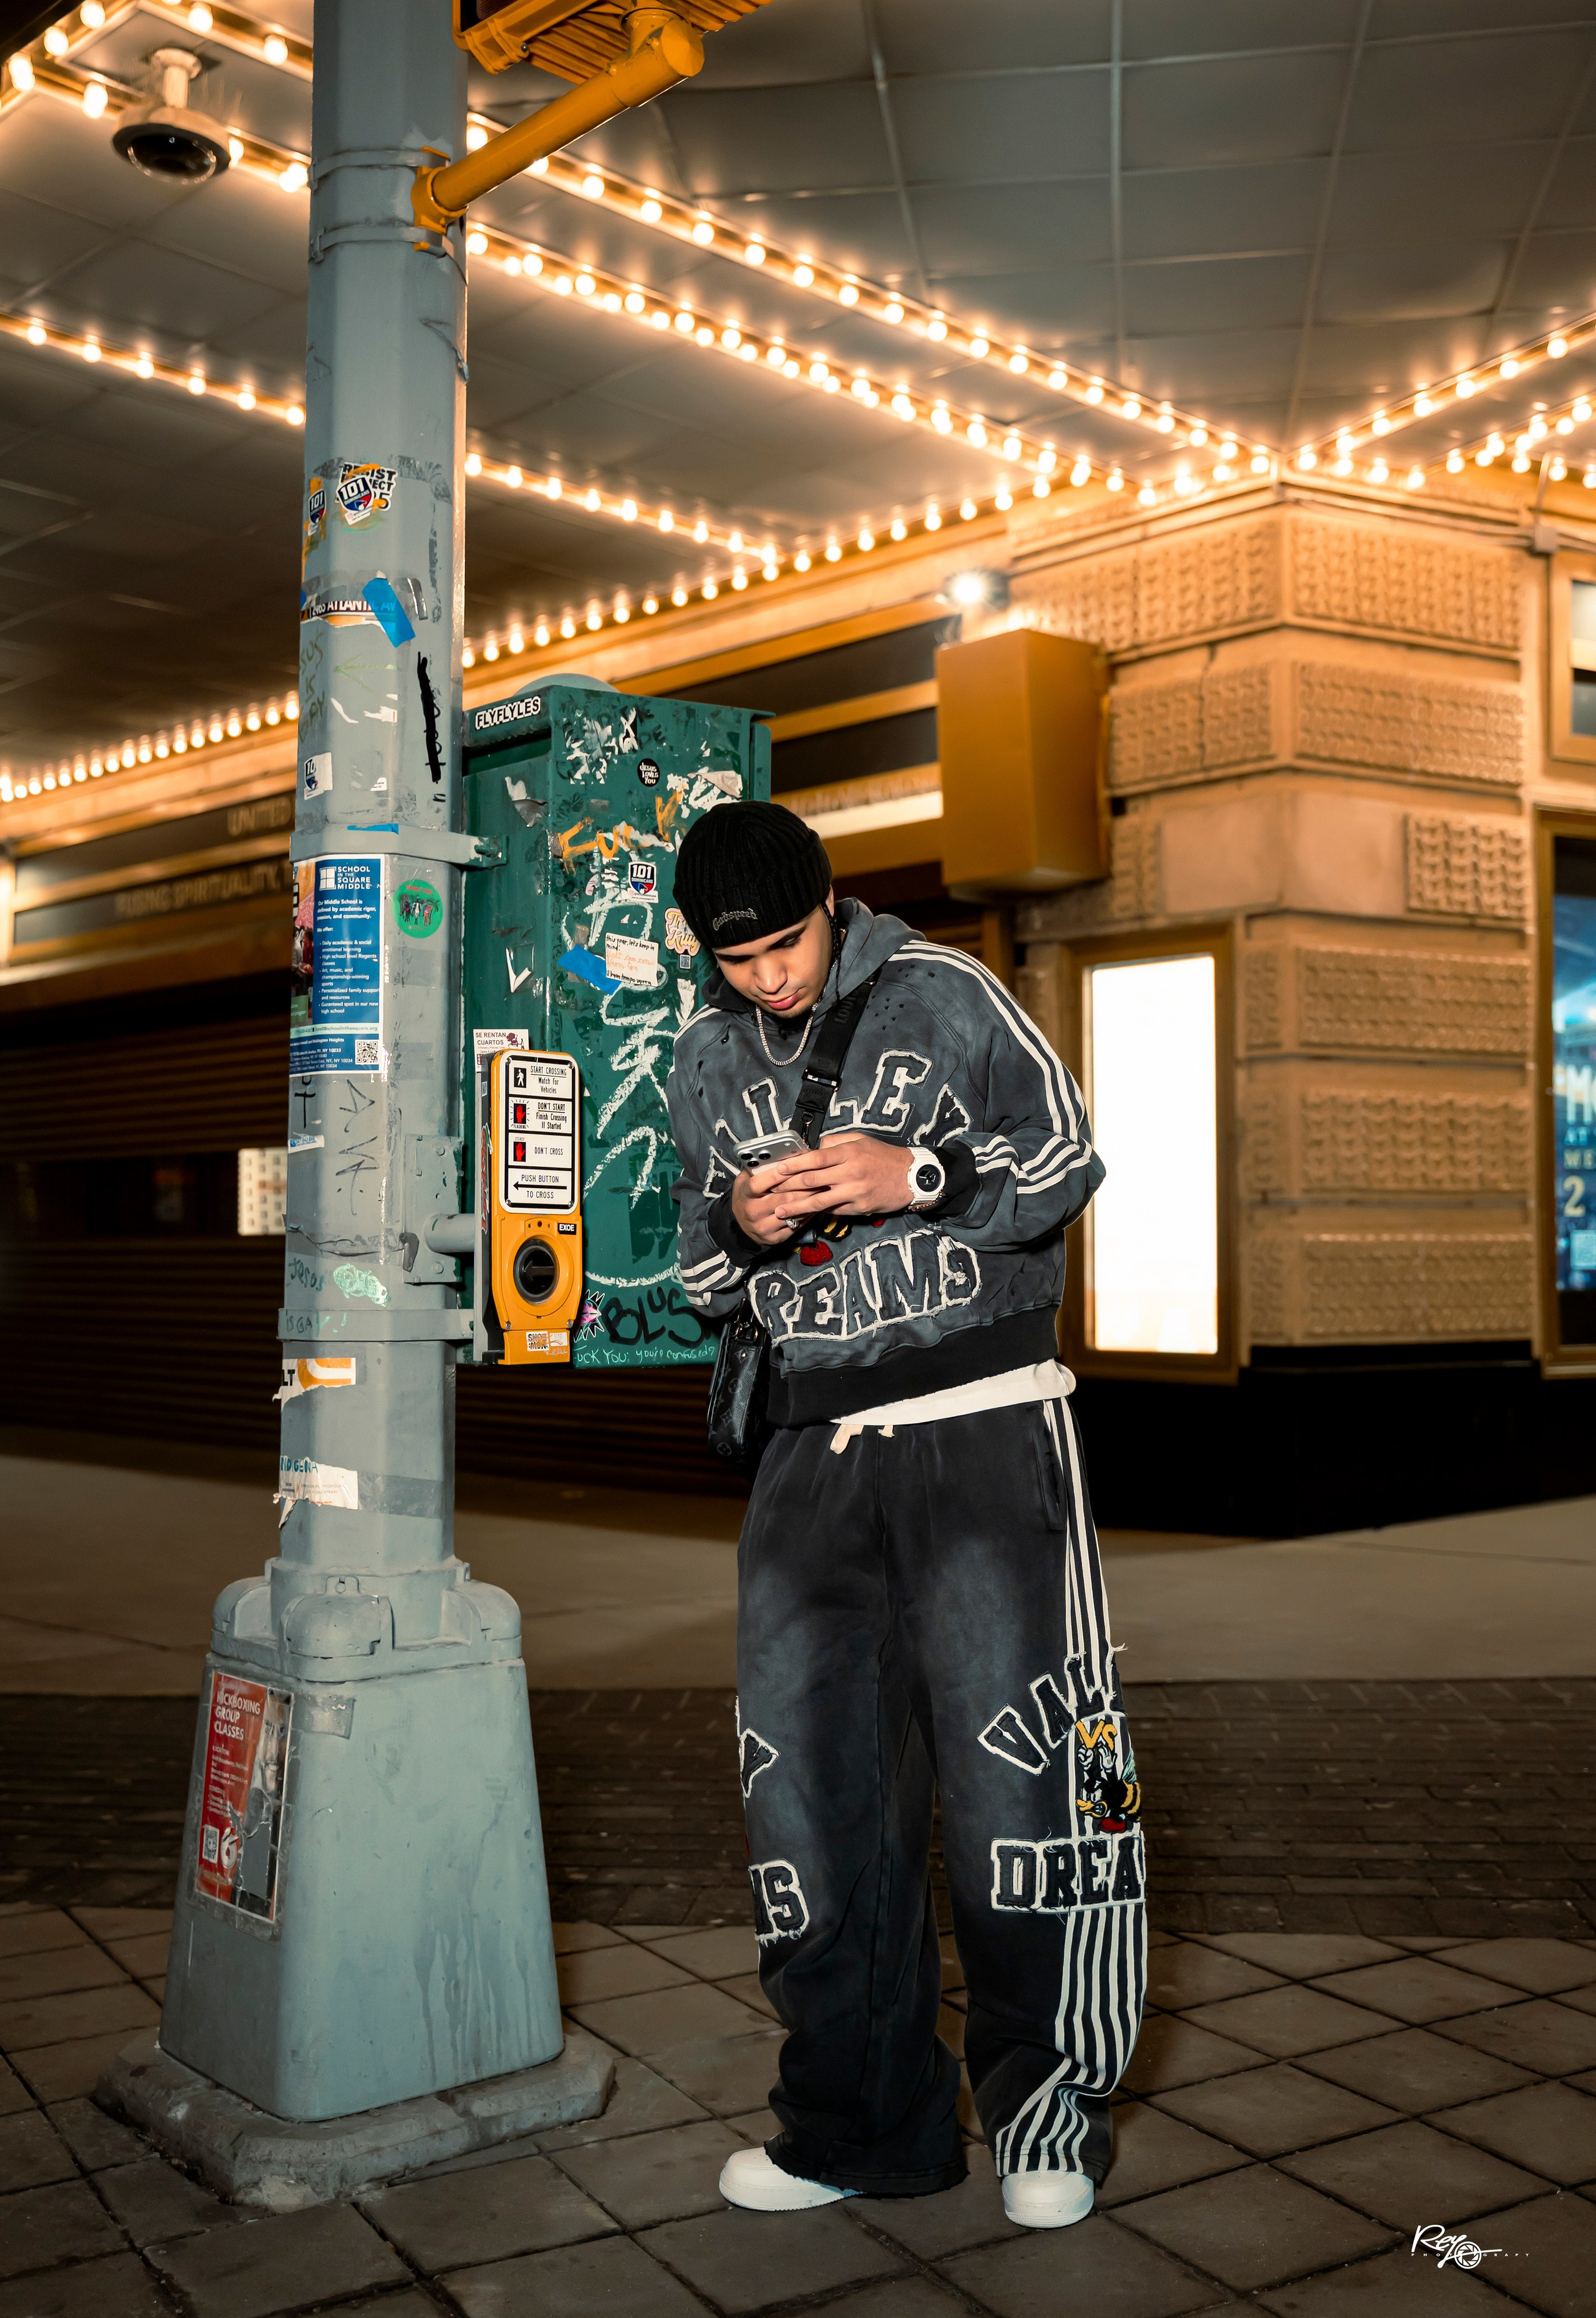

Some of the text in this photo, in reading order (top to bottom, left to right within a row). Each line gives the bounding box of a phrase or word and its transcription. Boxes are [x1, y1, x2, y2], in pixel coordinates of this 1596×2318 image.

[340, 478, 365, 500] 101
[311, 492, 323, 511] 101
[477, 697, 541, 728] FLYFLYLES
[632, 864, 652, 879] 101
[606, 934, 615, 942] this
[617, 938, 628, 946] year,
[629, 939, 638, 947] let's
[640, 940, 650, 950] keep
[621, 973, 636, 984] tempo
[546, 1067, 567, 1076] CROSSING
[538, 1076, 550, 1085] Watch
[541, 1086, 557, 1094] Vehicles
[537, 1102, 565, 1111] DON'T START
[536, 1112, 567, 1124] Finish Crossing
[547, 1122, 561, 1130] Started
[534, 1146, 563, 1156] DON'T CROSS
[521, 1174, 559, 1183] PUSH BUTTON
[536, 1190, 554, 1199] CROSS
[559, 1224, 574, 1232] EXOE
[215, 1706, 241, 1724] GROUP
[214, 1721, 244, 1741] CLASSES
